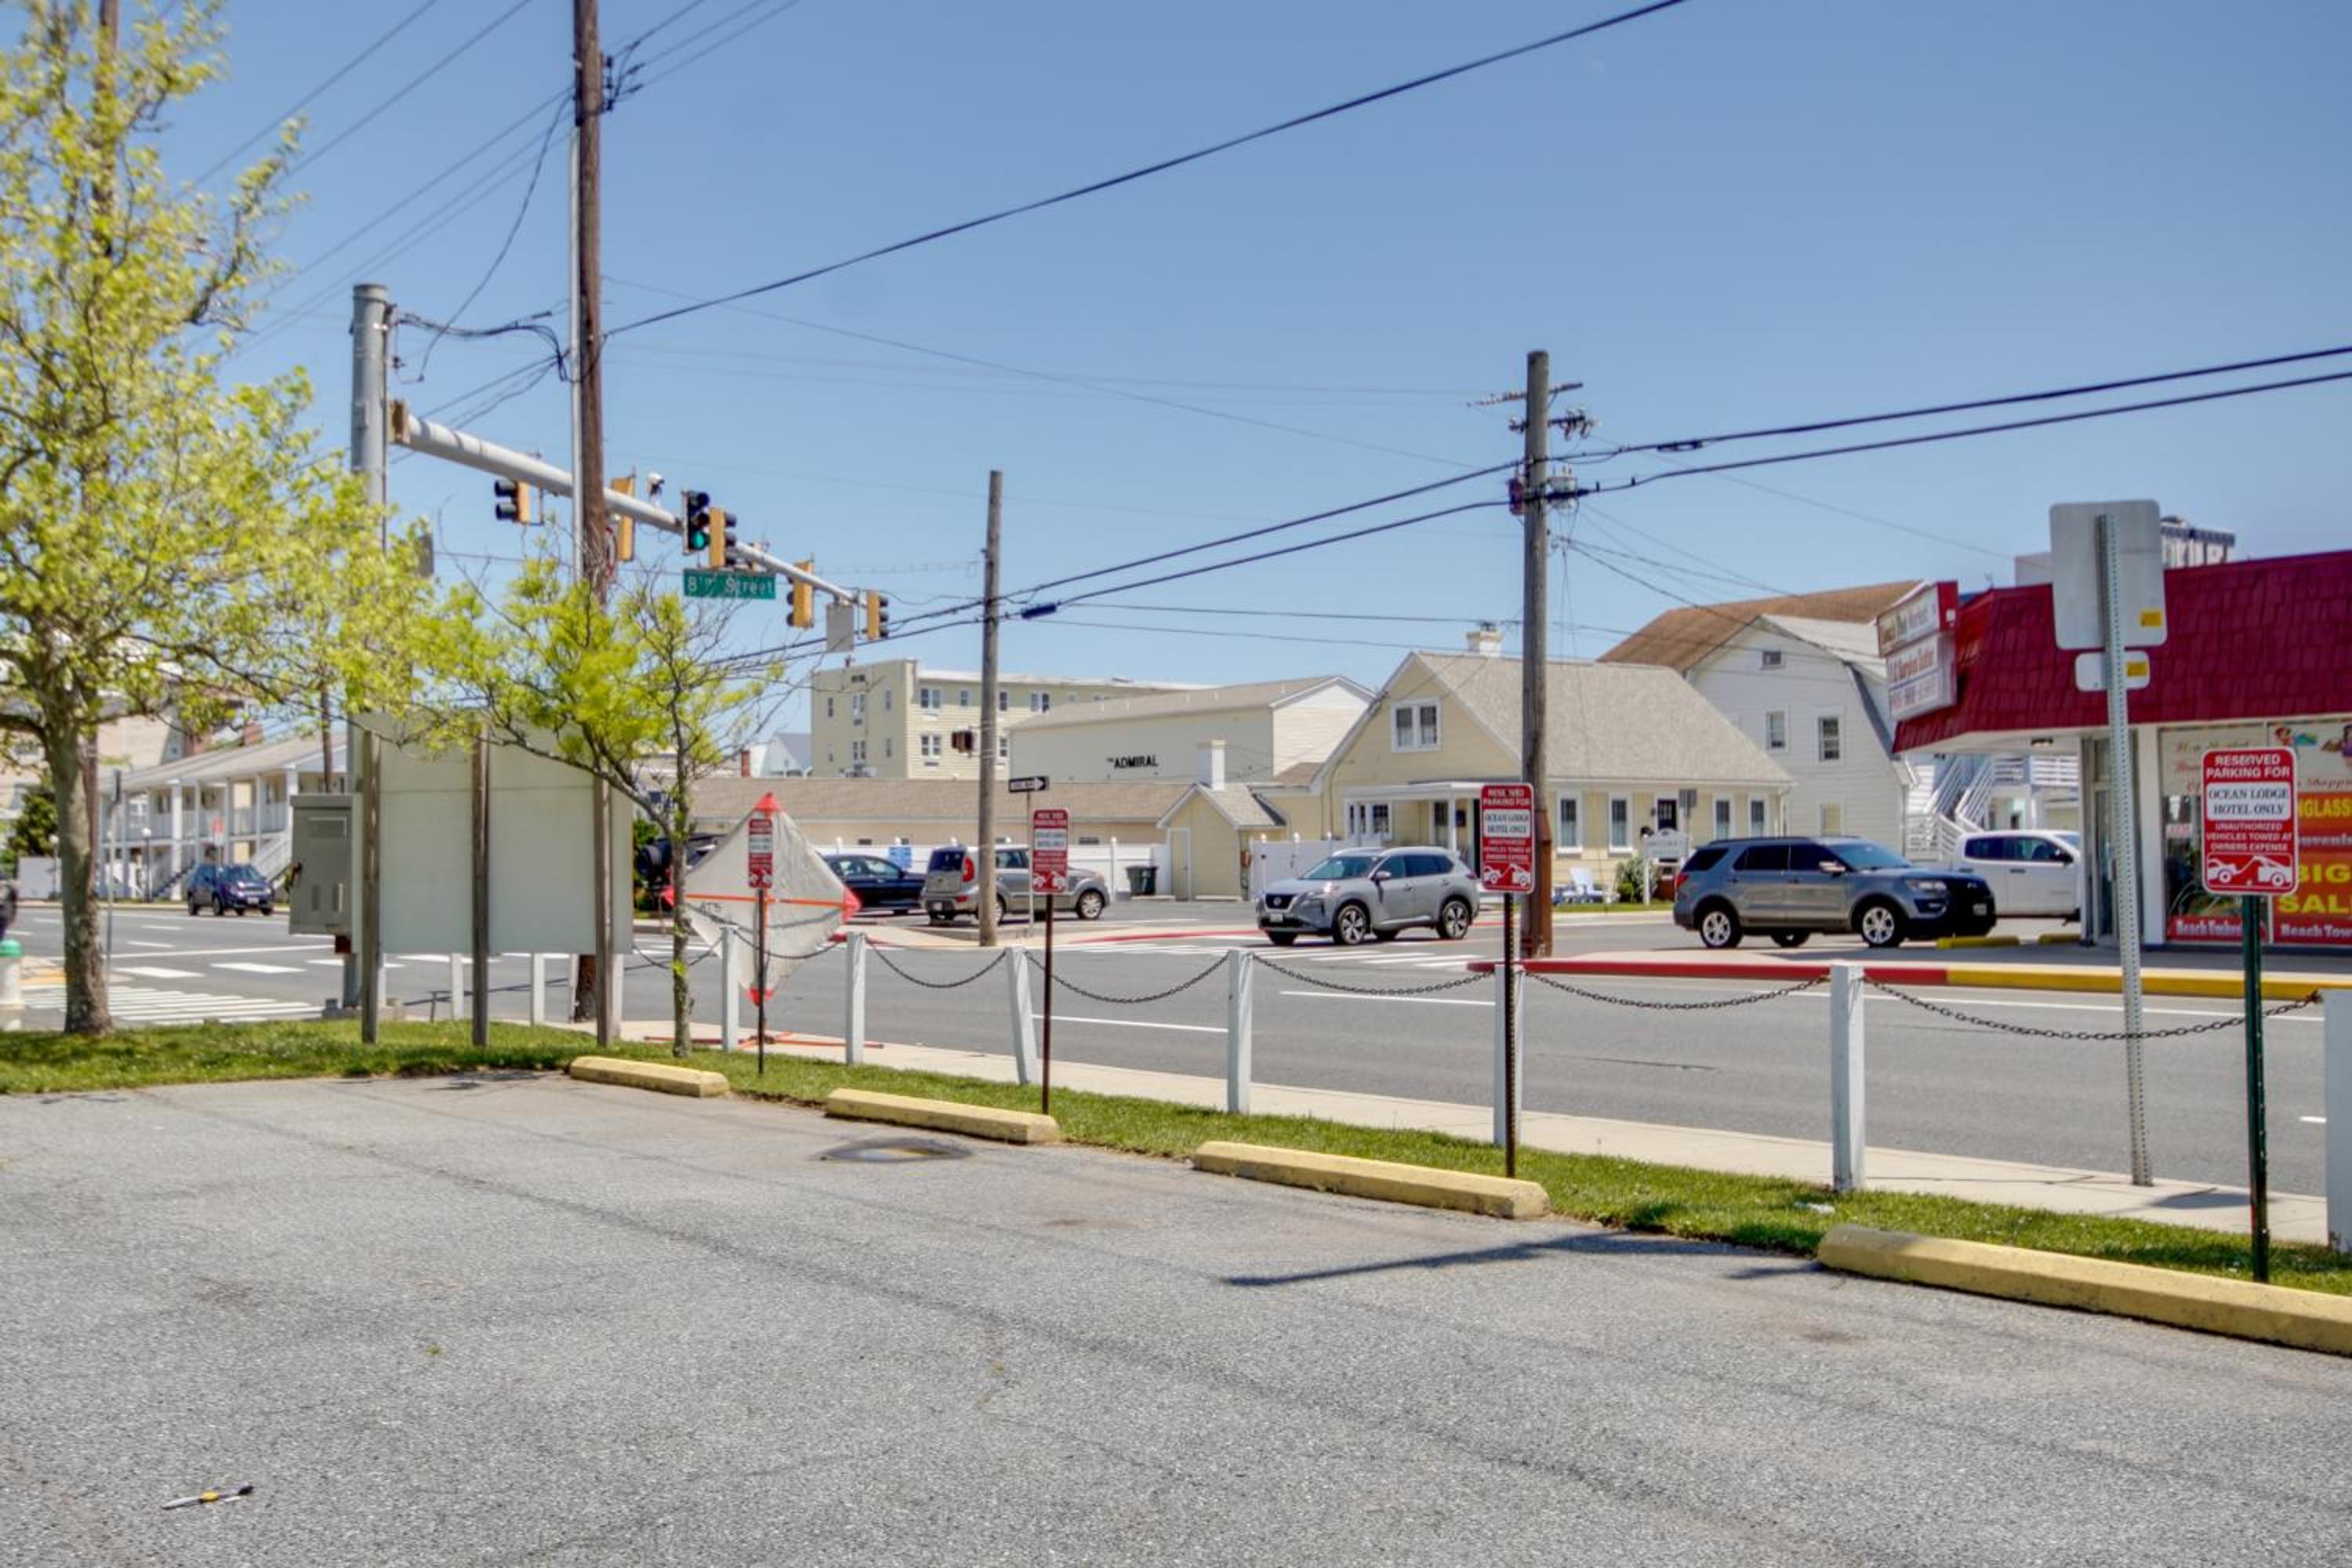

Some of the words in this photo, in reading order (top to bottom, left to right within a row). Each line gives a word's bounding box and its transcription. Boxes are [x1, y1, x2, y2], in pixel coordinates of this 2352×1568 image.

[726, 576, 773, 594] Street
[1115, 755, 1159, 768] ADMIRAL
[2215, 754, 2280, 766] RESERVED
[2206, 767, 2261, 779] PARKING
[2264, 766, 2289, 778] FOR
[2209, 789, 2247, 799] OCEAN
[2251, 789, 2287, 799] LODGE
[2213, 804, 2248, 814] HOTEL
[2253, 804, 2284, 814] ONLY
[2299, 798, 2352, 817] GLASS
[2206, 833, 2247, 841] VEHICLES
[2211, 843, 2247, 851] OWNERS
[2249, 843, 2287, 851] EXPENSE
[2278, 894, 2352, 914] SAL
[2281, 924, 2323, 937] Beach
